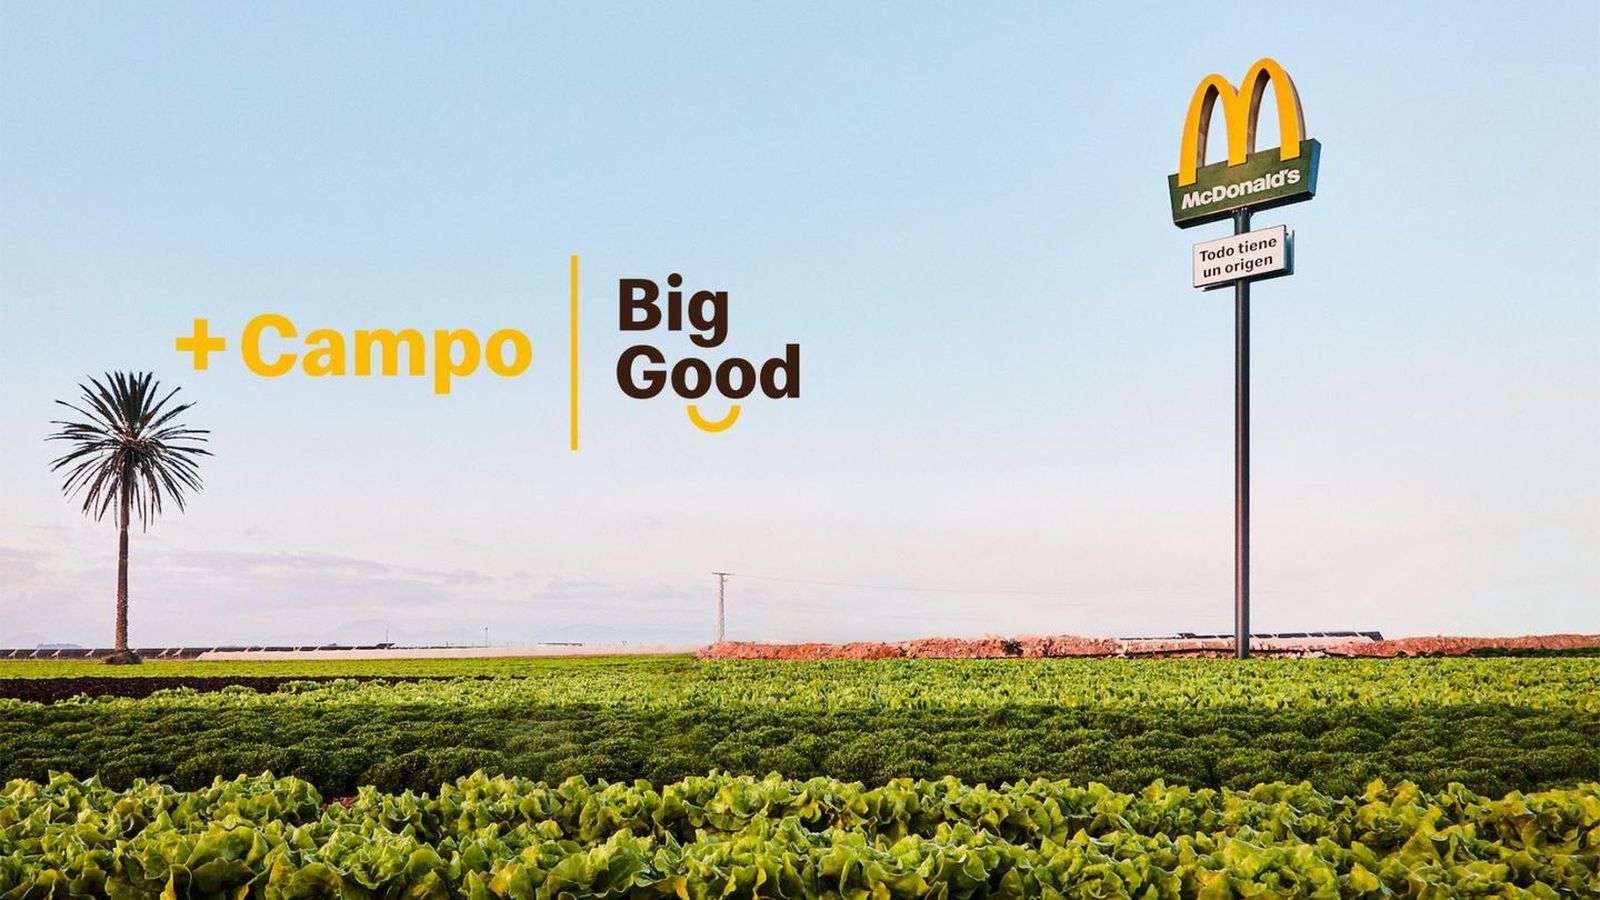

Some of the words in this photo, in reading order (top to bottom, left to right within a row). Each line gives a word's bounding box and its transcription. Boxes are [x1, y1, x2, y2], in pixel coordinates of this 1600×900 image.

[1181, 168, 1301, 210] McDonald's
[1199, 246, 1235, 262] Todo
[1238, 235, 1277, 254] tiene
[1202, 266, 1221, 278] un
[1225, 254, 1274, 273] origen
